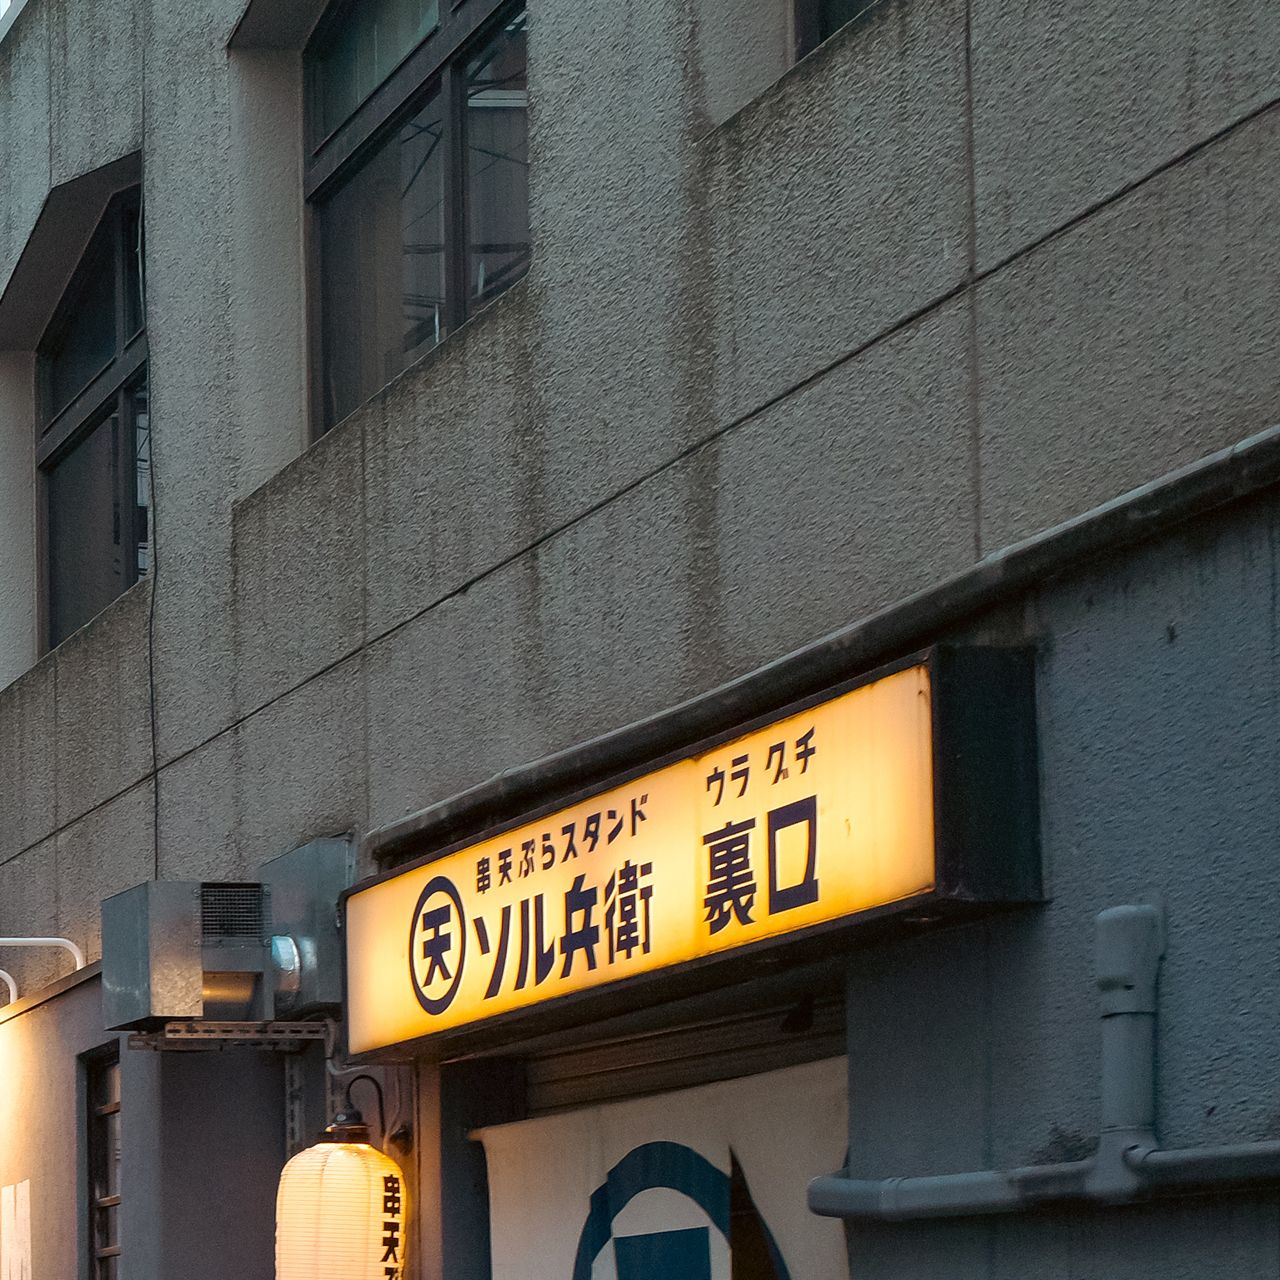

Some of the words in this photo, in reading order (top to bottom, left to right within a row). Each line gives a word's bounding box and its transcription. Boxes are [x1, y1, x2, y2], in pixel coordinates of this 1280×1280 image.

[474, 860, 654, 1000] ソル兵衛
[703, 795, 820, 935] 裏口
[477, 793, 649, 894] 串天ぷらスタンド
